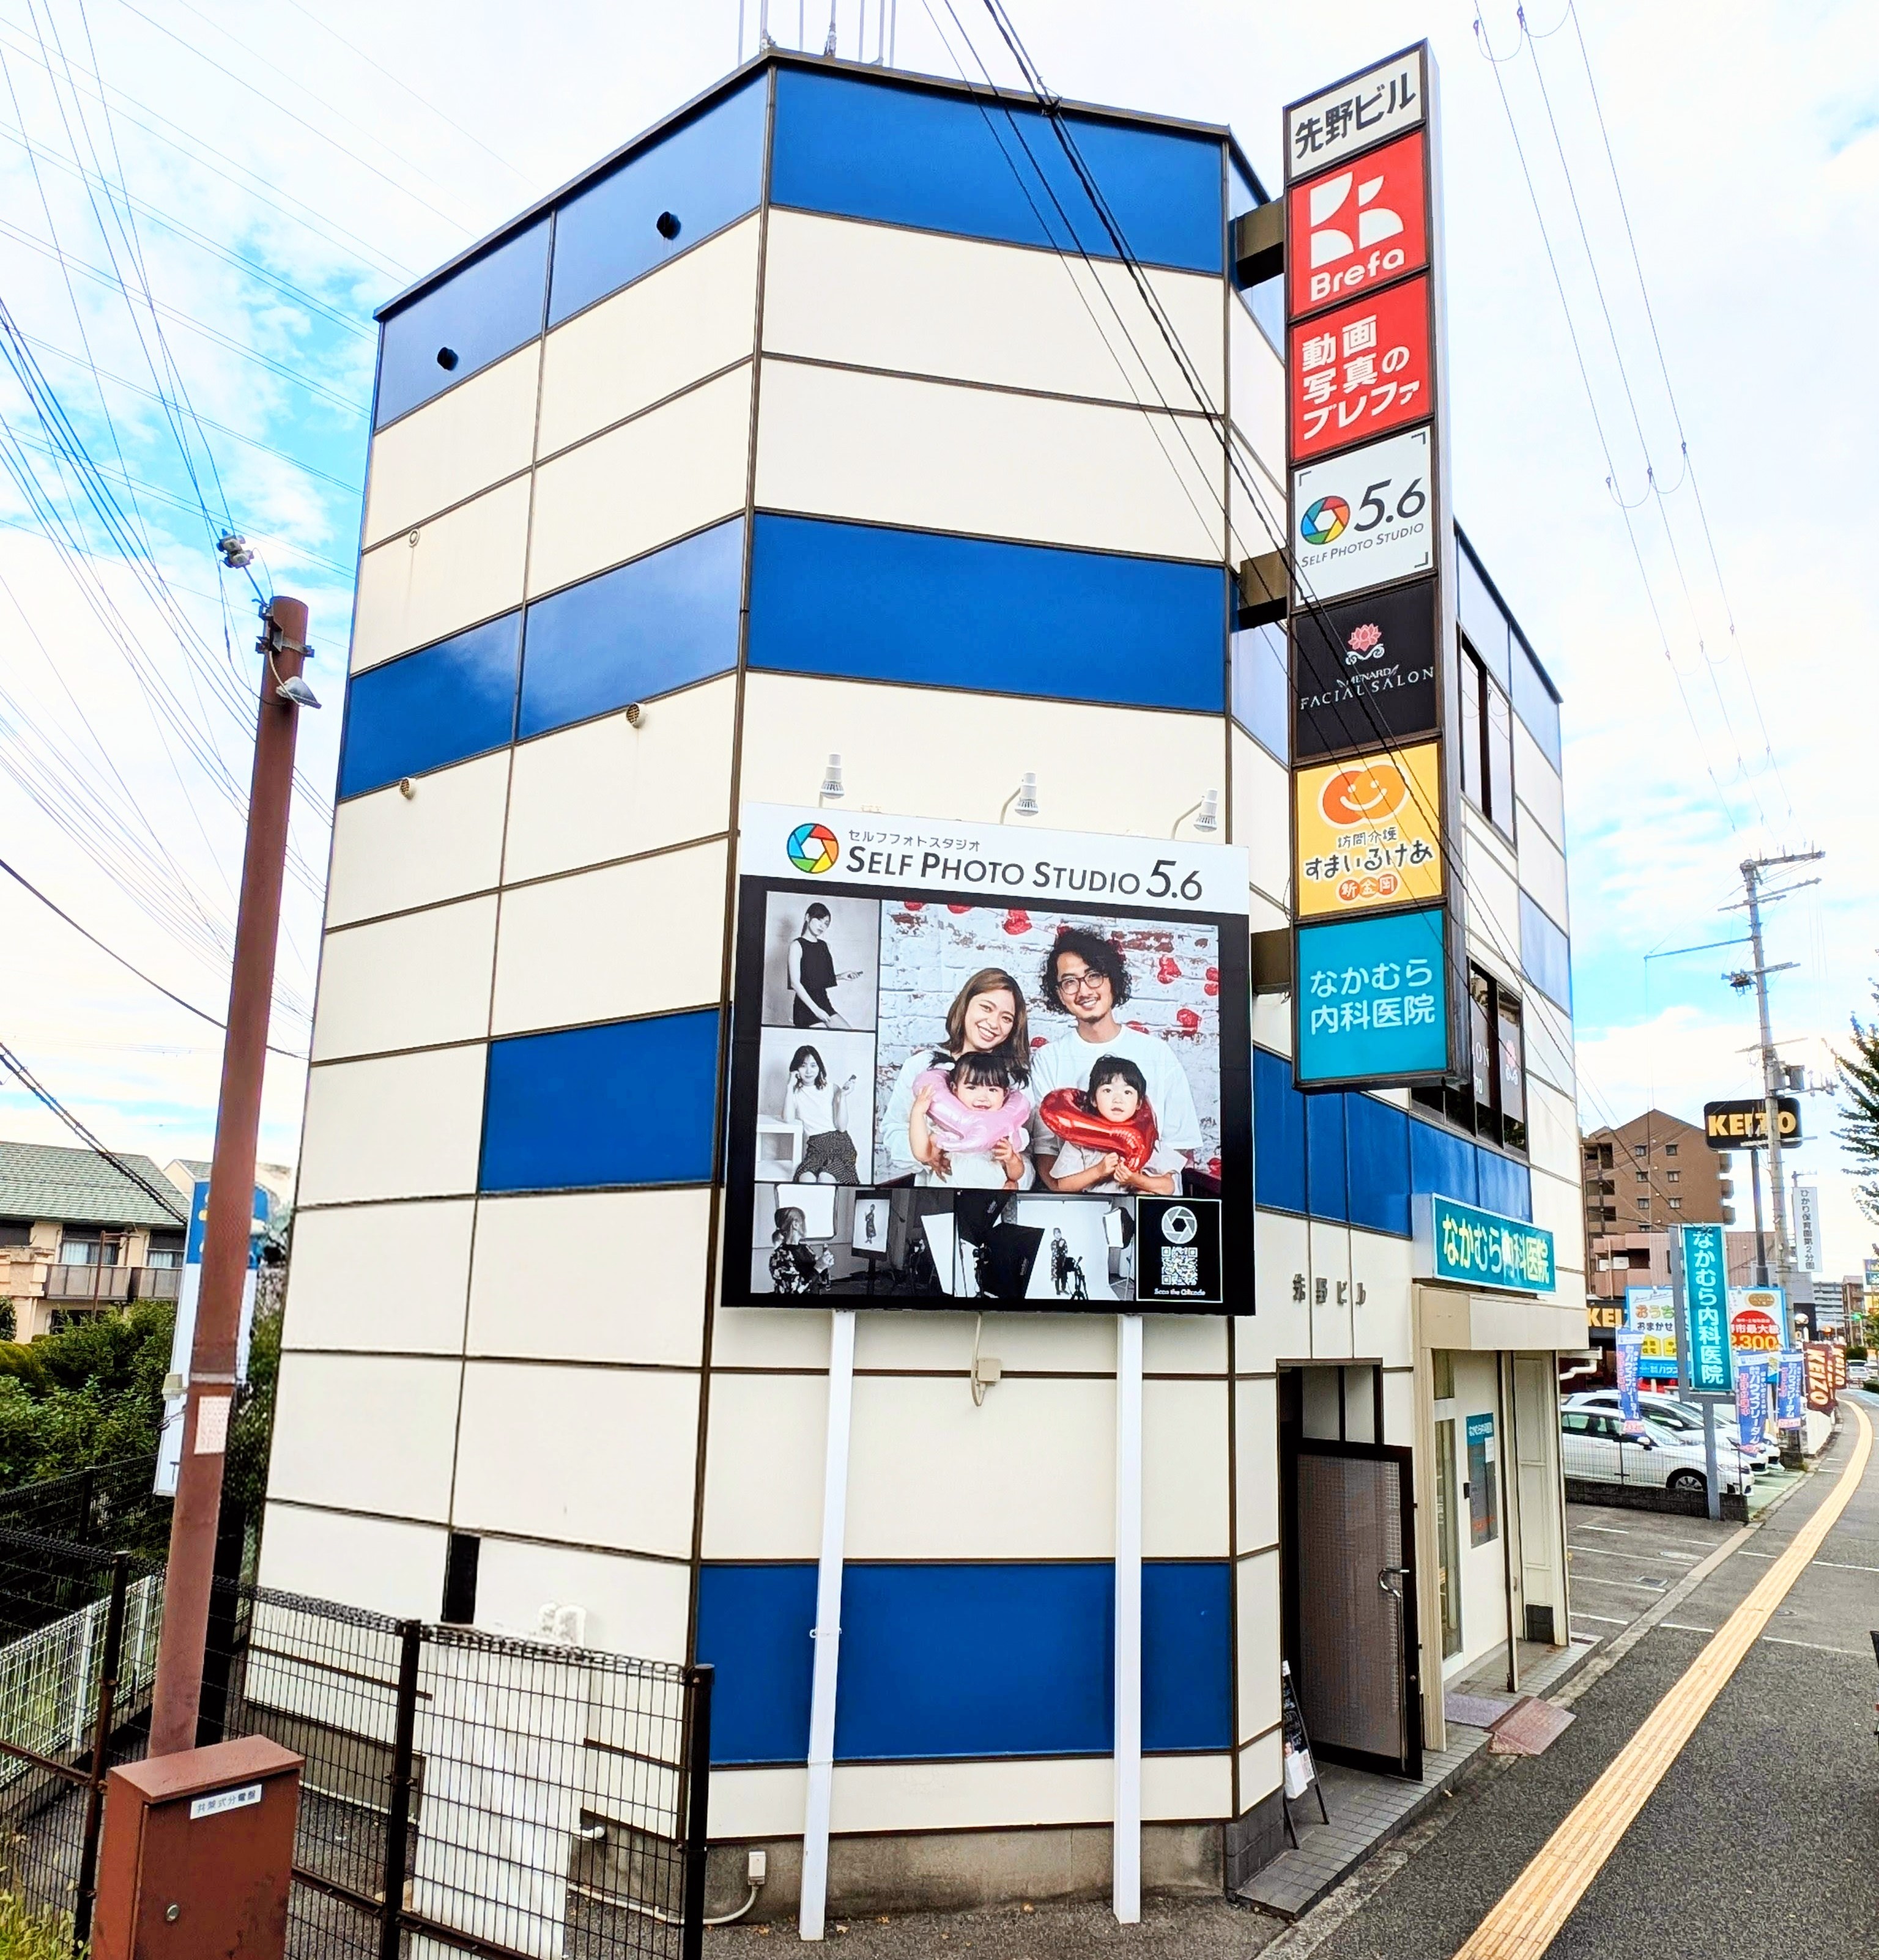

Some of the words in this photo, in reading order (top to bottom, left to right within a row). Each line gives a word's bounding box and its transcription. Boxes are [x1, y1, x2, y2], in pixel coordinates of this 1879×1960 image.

[1295, 72, 1417, 160] 先野ビル
[1310, 248, 1405, 301] Brefa
[1302, 314, 1377, 372] 動画
[1303, 346, 1410, 405] 写真の
[1303, 380, 1420, 441] ブレファ
[1354, 477, 1426, 531] 5.6
[1301, 552, 1332, 568] SELF
[1330, 539, 1373, 560] PHOTO
[1376, 523, 1424, 545] STUDIO
[1300, 684, 1365, 710] FACIAL
[1371, 667, 1434, 693] SALON
[848, 829, 980, 852] セルフフォトスタジオ
[1305, 840, 1434, 880] すまいるけあ
[1338, 826, 1397, 848] 訪問介護
[846, 846, 914, 876] SELF
[920, 852, 1025, 885] PHOTO
[1032, 861, 1141, 895] STUDIO
[1146, 859, 1203, 901] 5.6
[1340, 875, 1397, 898] 新金岡
[1310, 958, 1432, 998] なかむら
[1310, 993, 1436, 1035] 内科医院
[1442, 1213, 1550, 1284] なかむら内科医院
[1692, 1229, 1724, 1385] なかむら内科医院
[1807, 1348, 1829, 1405] KEIZO
